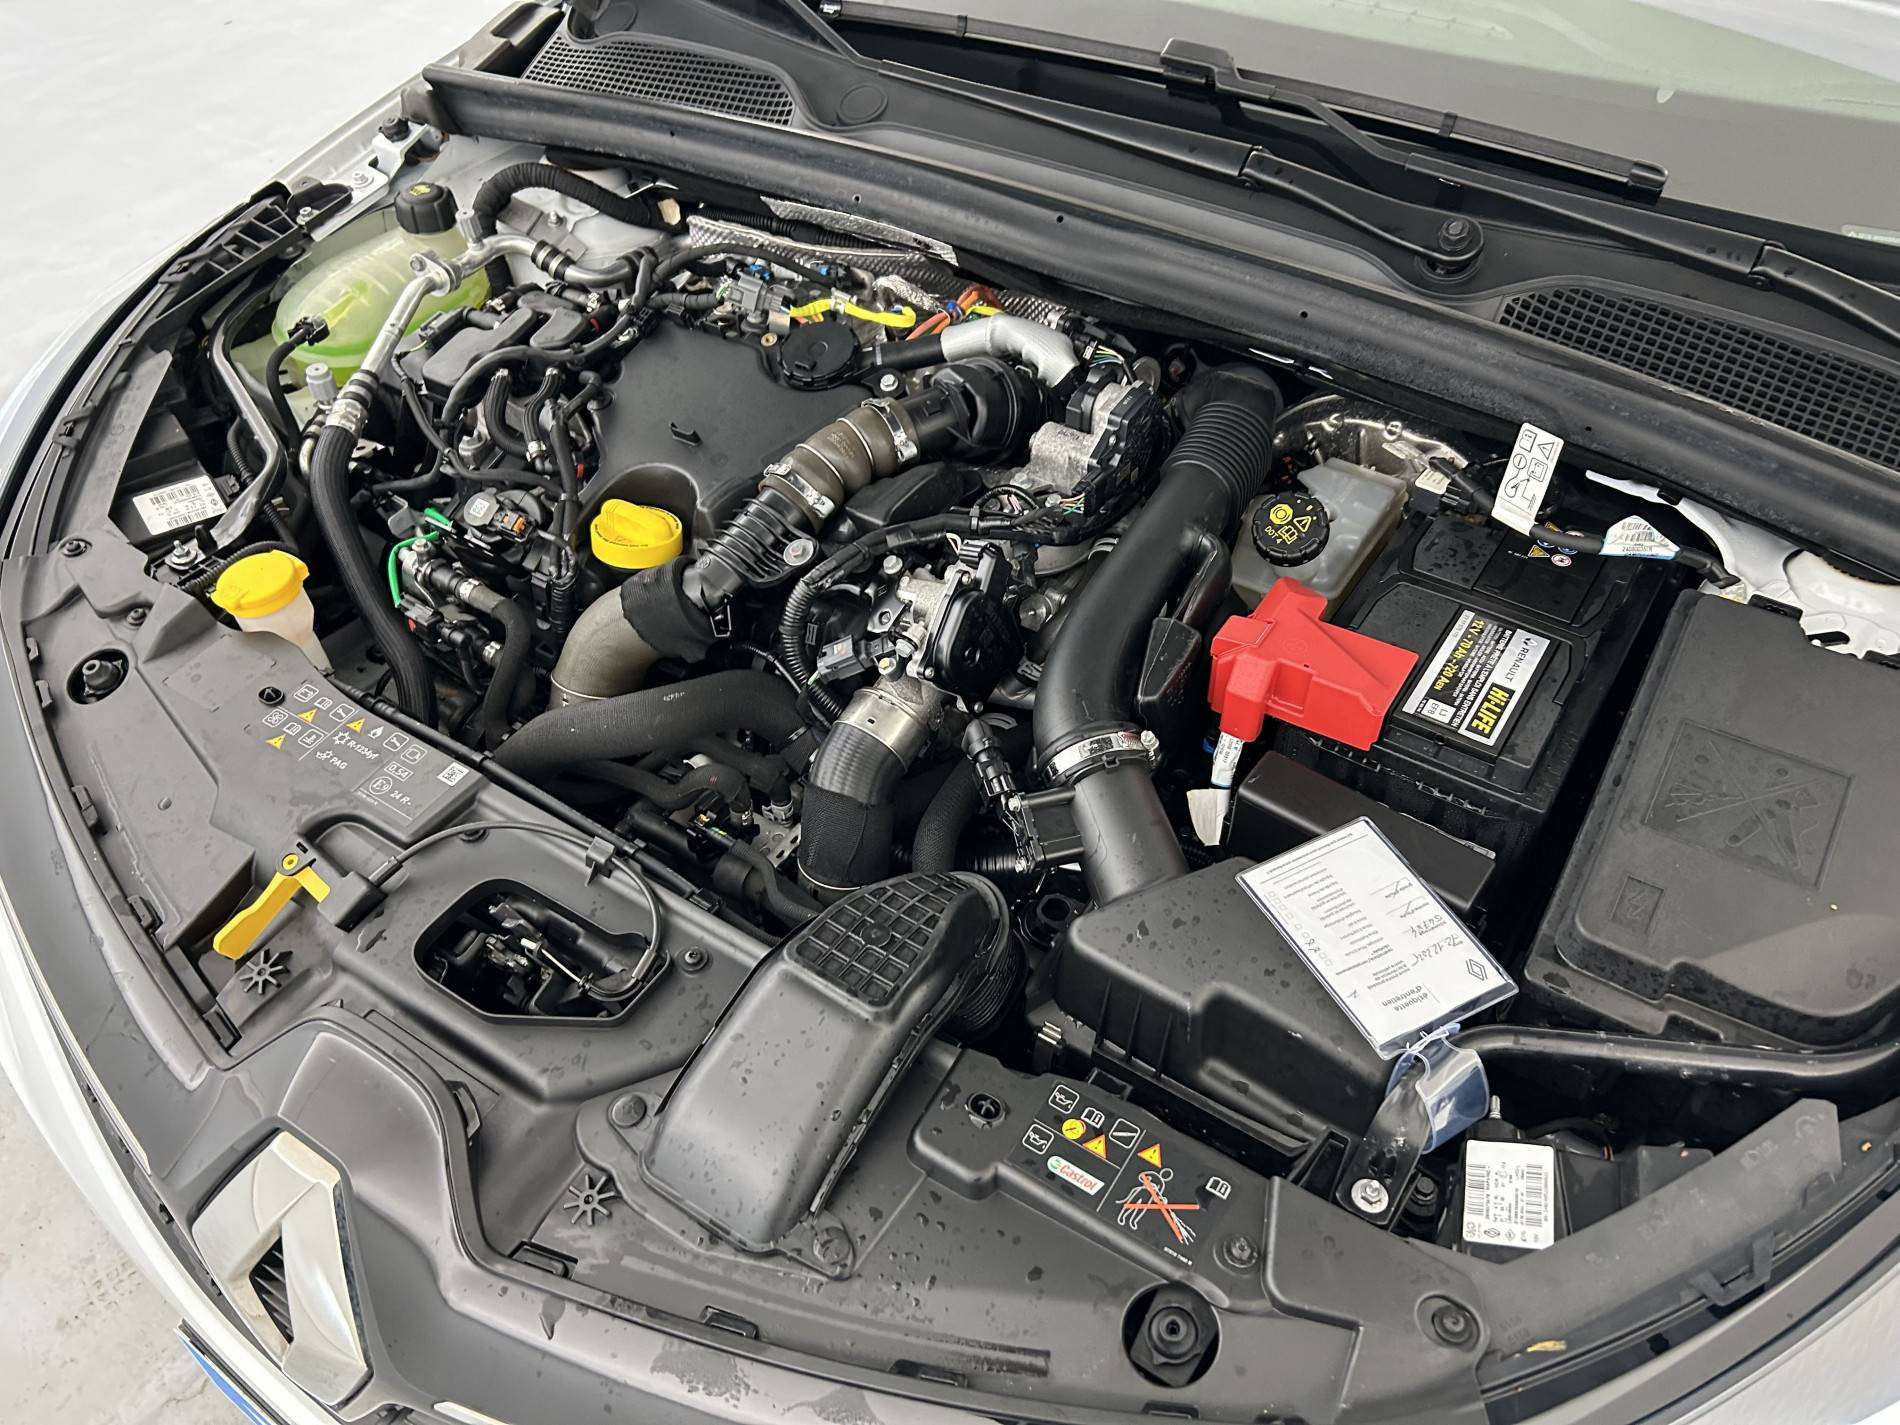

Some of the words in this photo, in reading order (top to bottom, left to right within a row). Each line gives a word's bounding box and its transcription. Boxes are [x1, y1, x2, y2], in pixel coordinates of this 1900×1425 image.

[1264, 525, 1278, 538] DOT
[1496, 629, 1513, 650] BATTERIE
[1505, 647, 1529, 682] RENAULT
[1451, 698, 1471, 727] ENTRETIEN
[329, 756, 348, 769] PAG
[1382, 985, 1422, 1007] d'entretien
[1394, 992, 1429, 1012] étiquette
[1060, 1165, 1098, 1190] Castrol
